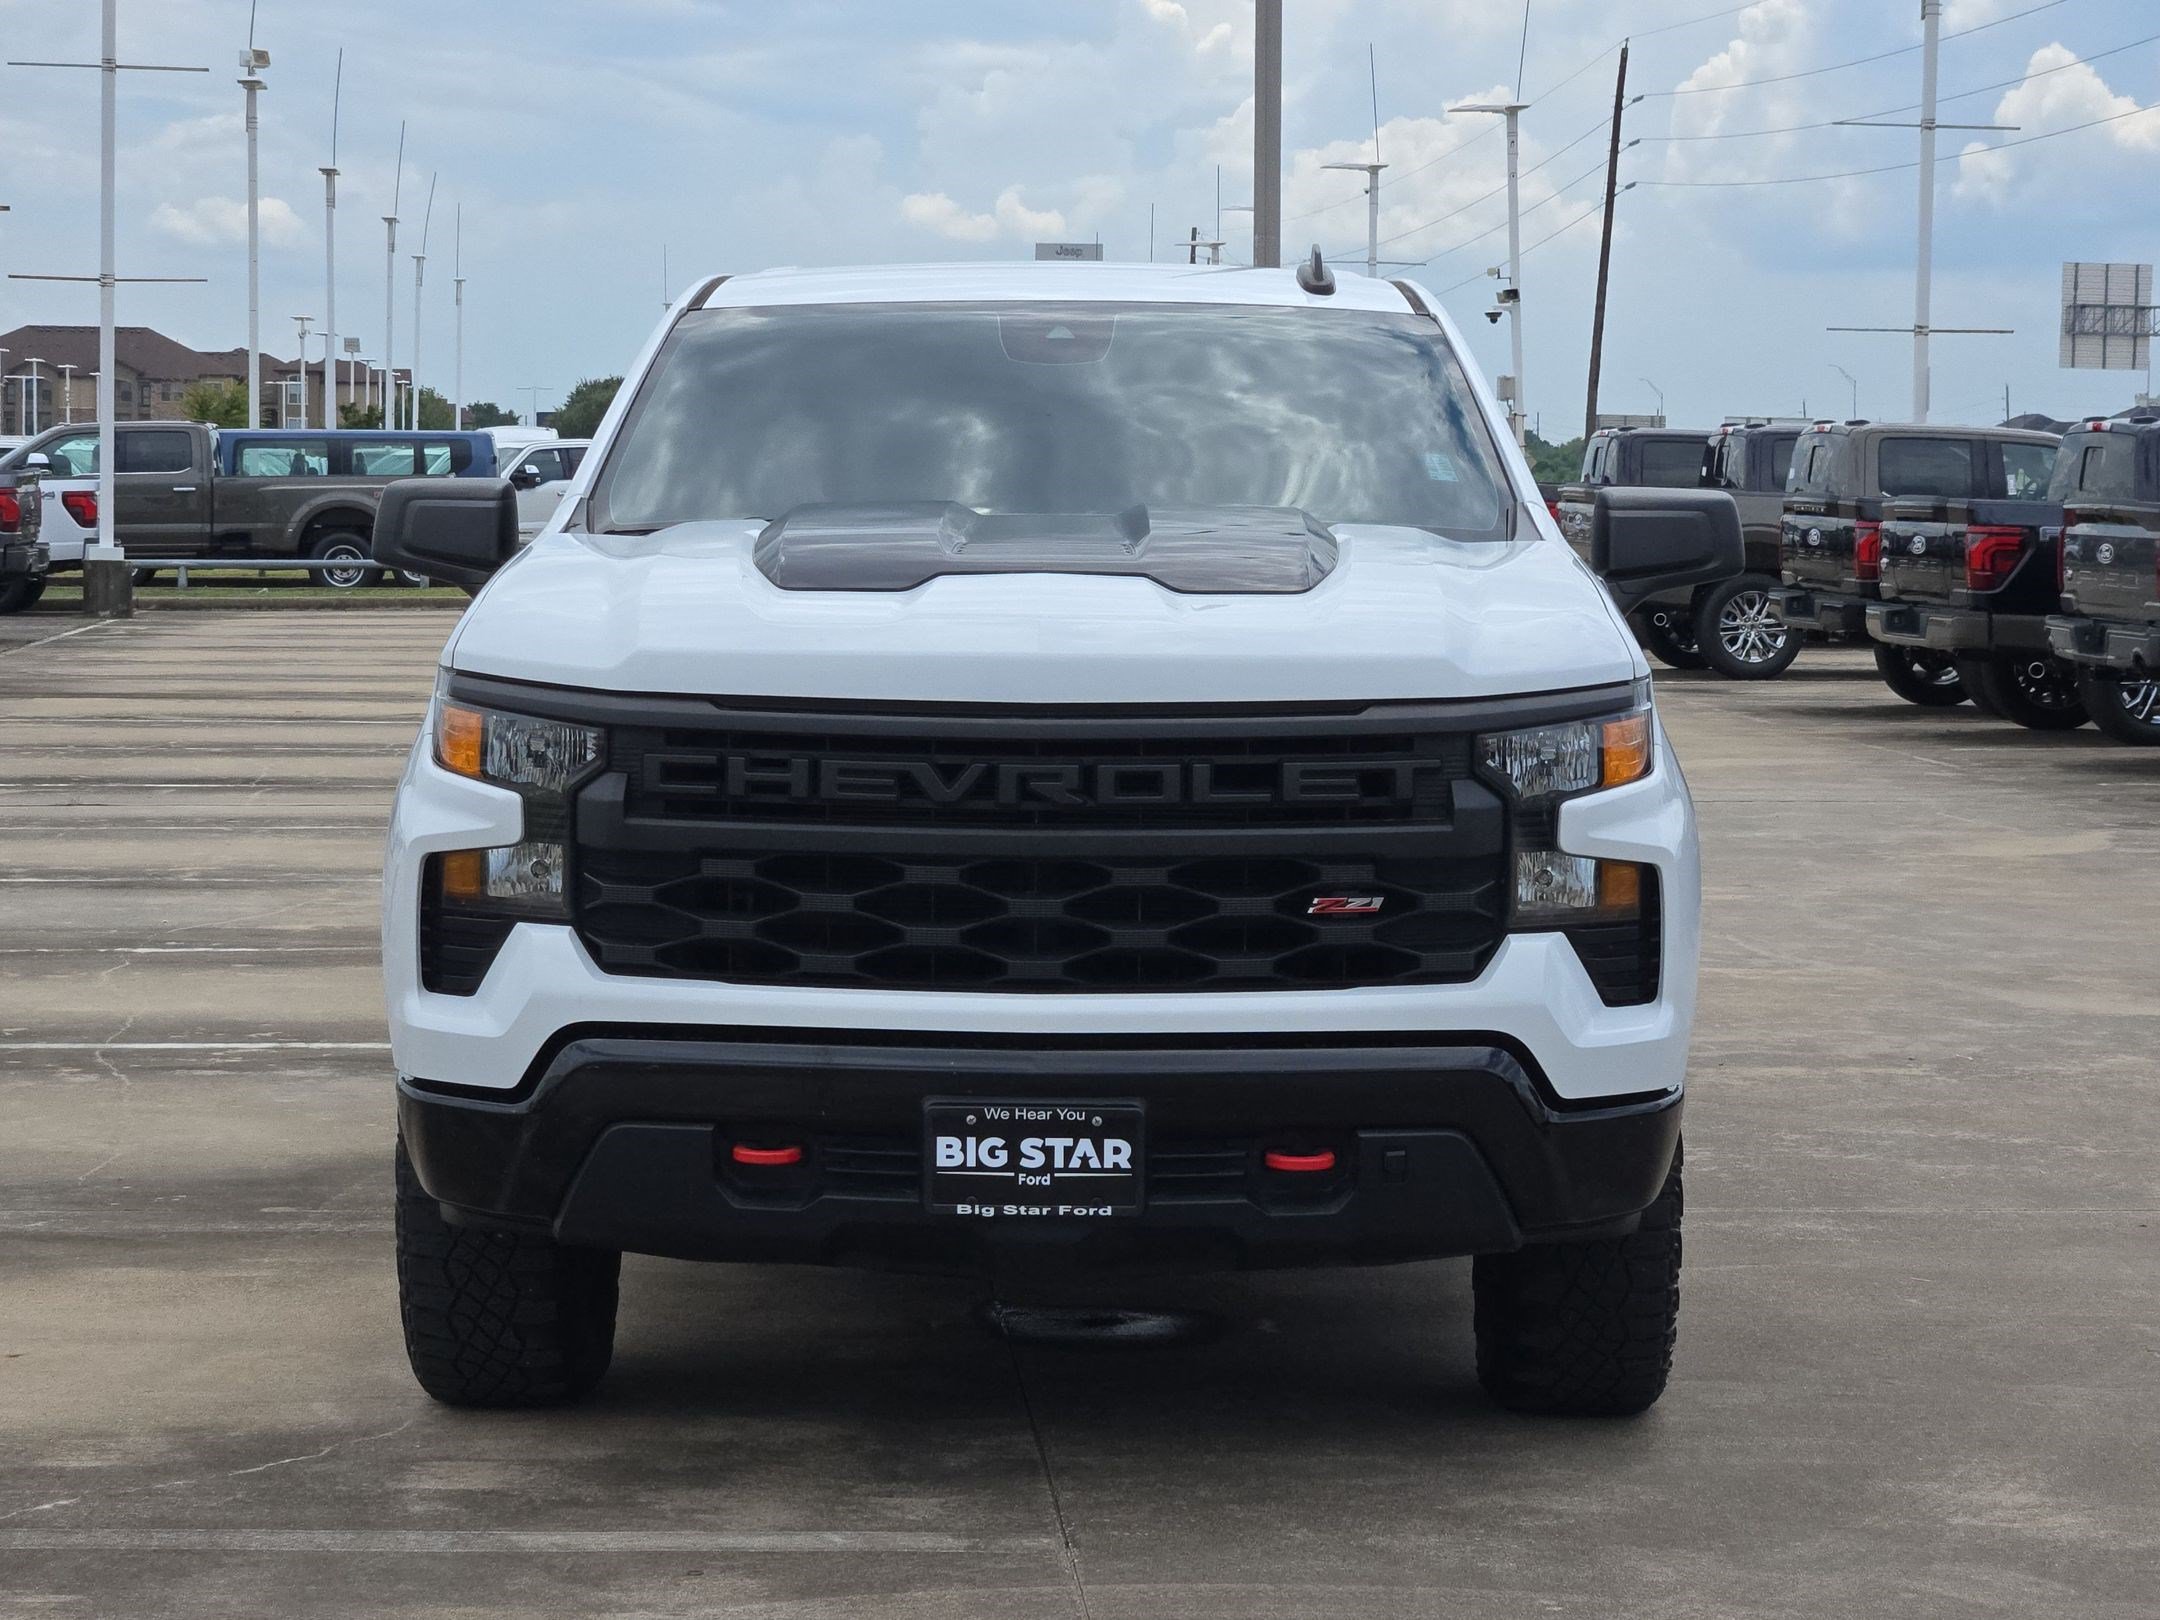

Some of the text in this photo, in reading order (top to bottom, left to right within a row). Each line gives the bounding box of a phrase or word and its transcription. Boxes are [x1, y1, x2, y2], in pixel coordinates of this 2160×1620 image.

[642, 752, 1442, 802] CHEVROLET
[984, 1107, 1086, 1121] We Hear You
[936, 1136, 1132, 1169] BIG STAR
[1018, 1173, 1051, 1186] Ford
[957, 1204, 1112, 1217] Big Star Ford
